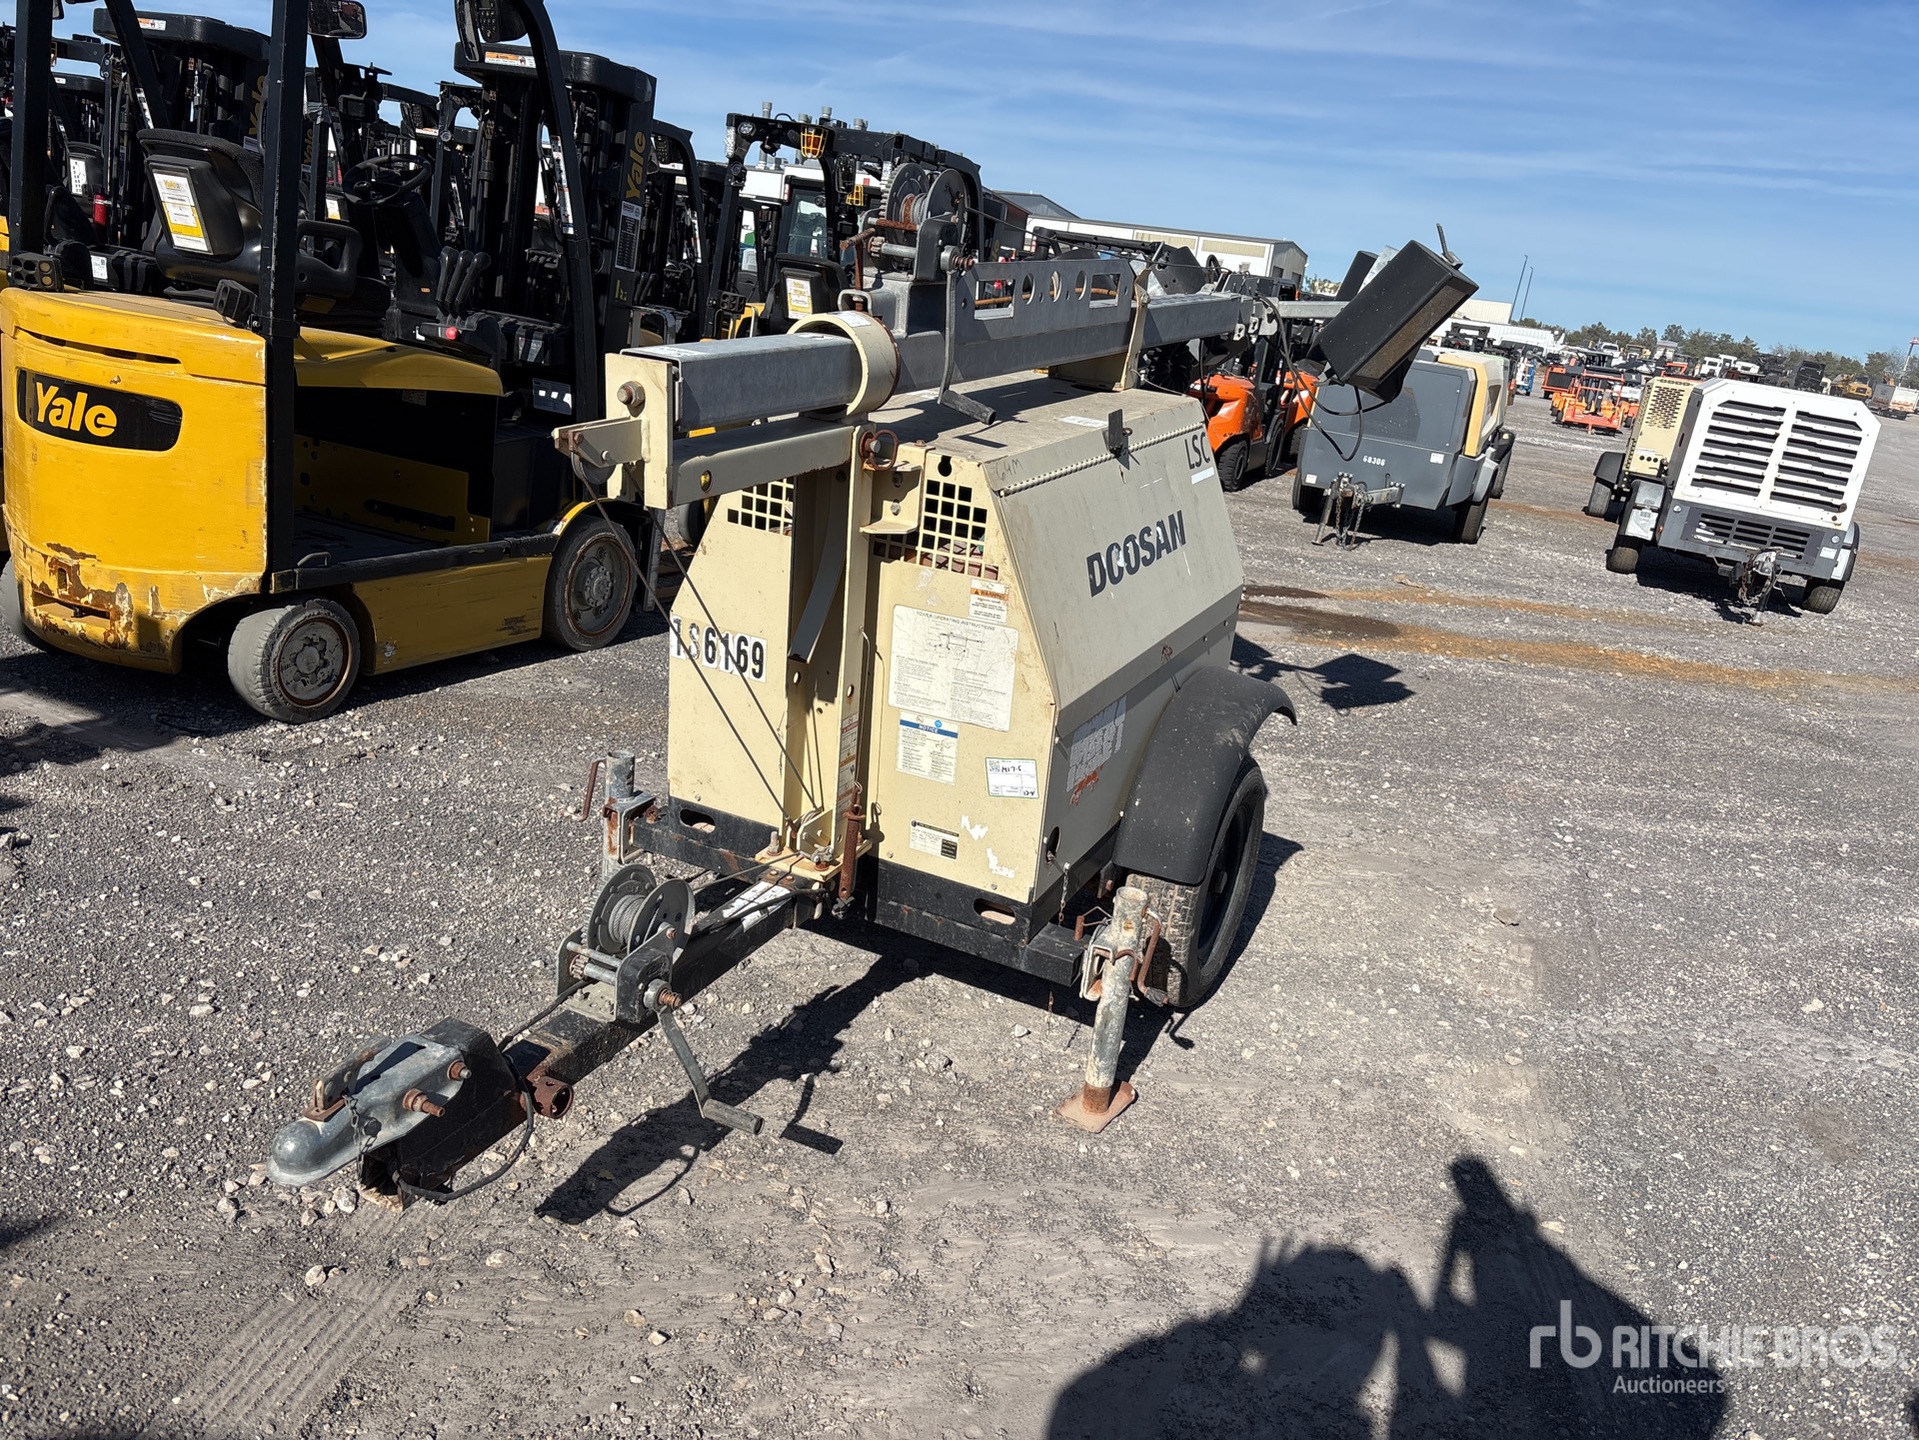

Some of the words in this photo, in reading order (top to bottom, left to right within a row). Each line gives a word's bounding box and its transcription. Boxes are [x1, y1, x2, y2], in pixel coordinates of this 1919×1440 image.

[625, 131, 647, 199] Yale
[36, 382, 118, 437] Yale
[1184, 431, 1211, 470] LSC
